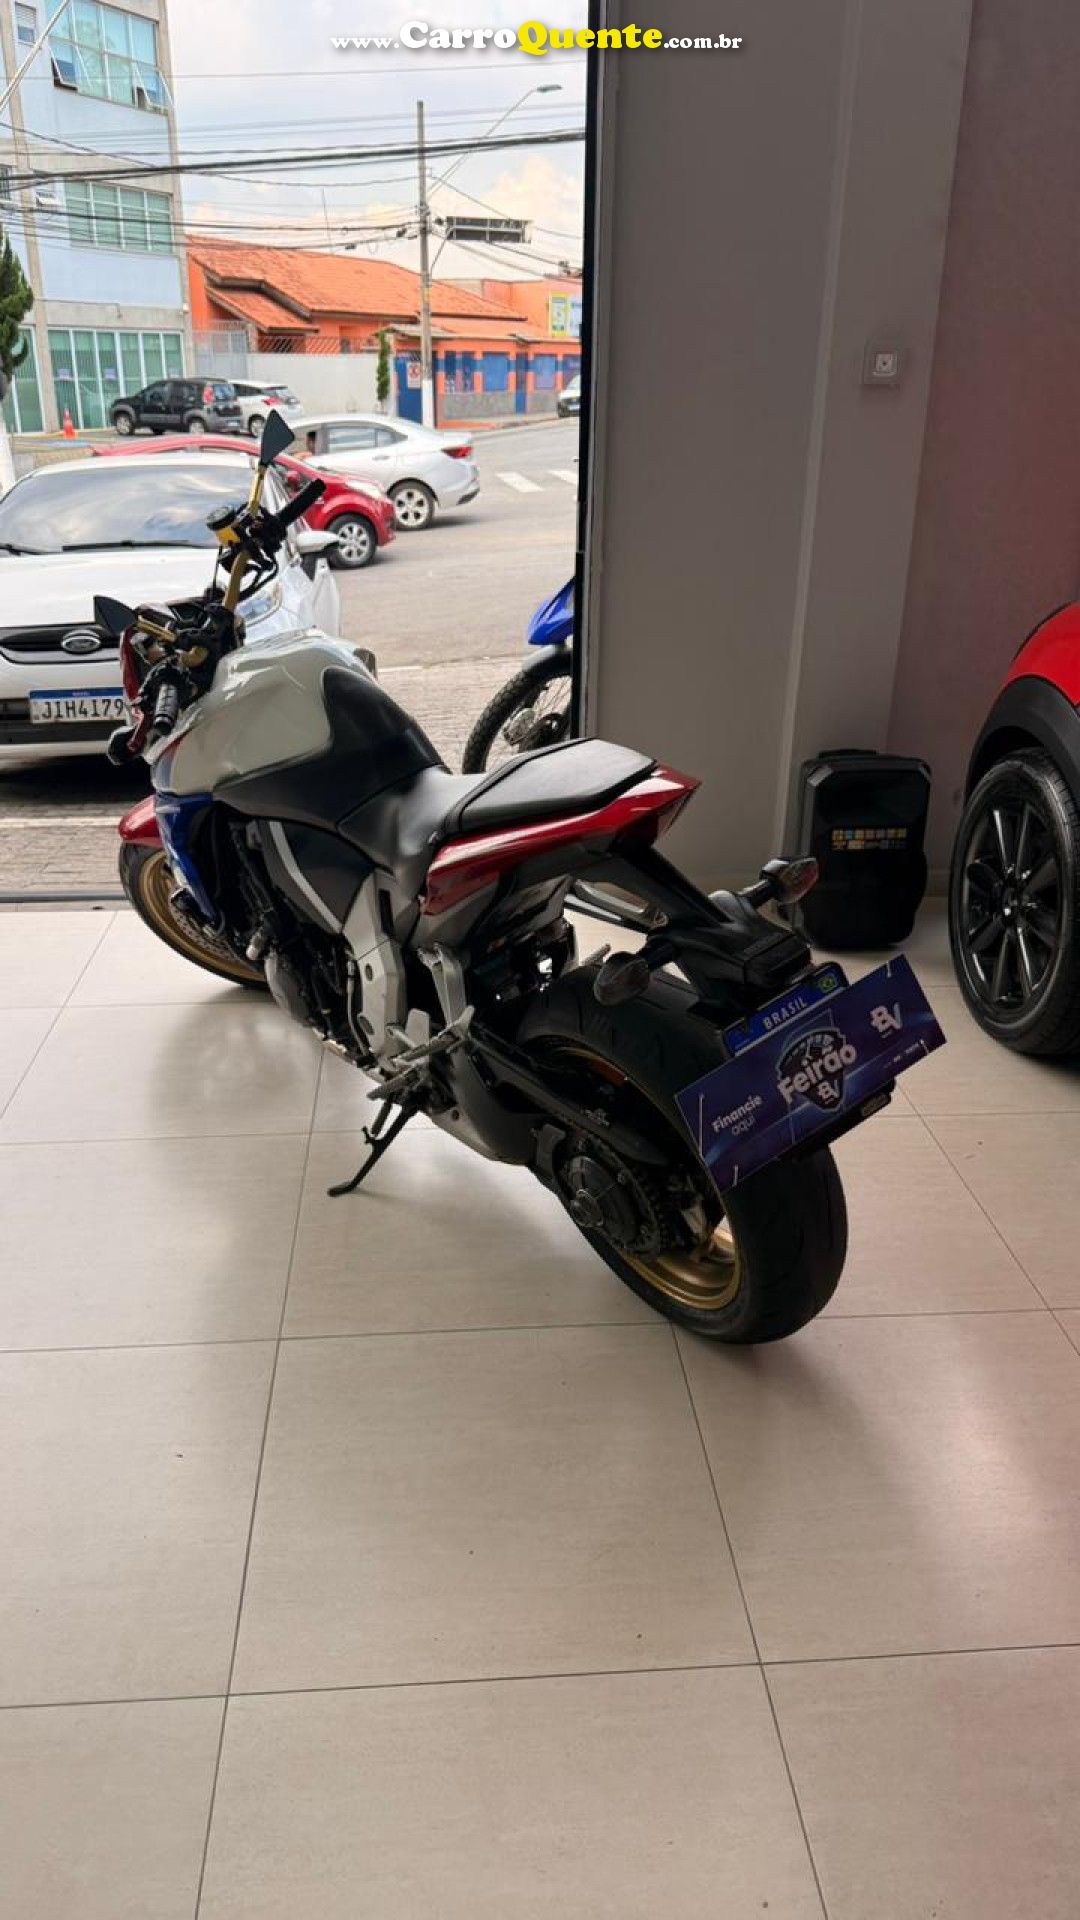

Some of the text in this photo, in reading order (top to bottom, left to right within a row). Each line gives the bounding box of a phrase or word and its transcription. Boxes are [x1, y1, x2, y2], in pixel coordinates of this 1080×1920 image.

[763, 996, 807, 1030] BRASIL
[776, 1043, 857, 1105] Feirão
[711, 1094, 762, 1133] Financie
[731, 1115, 756, 1137] aqui
